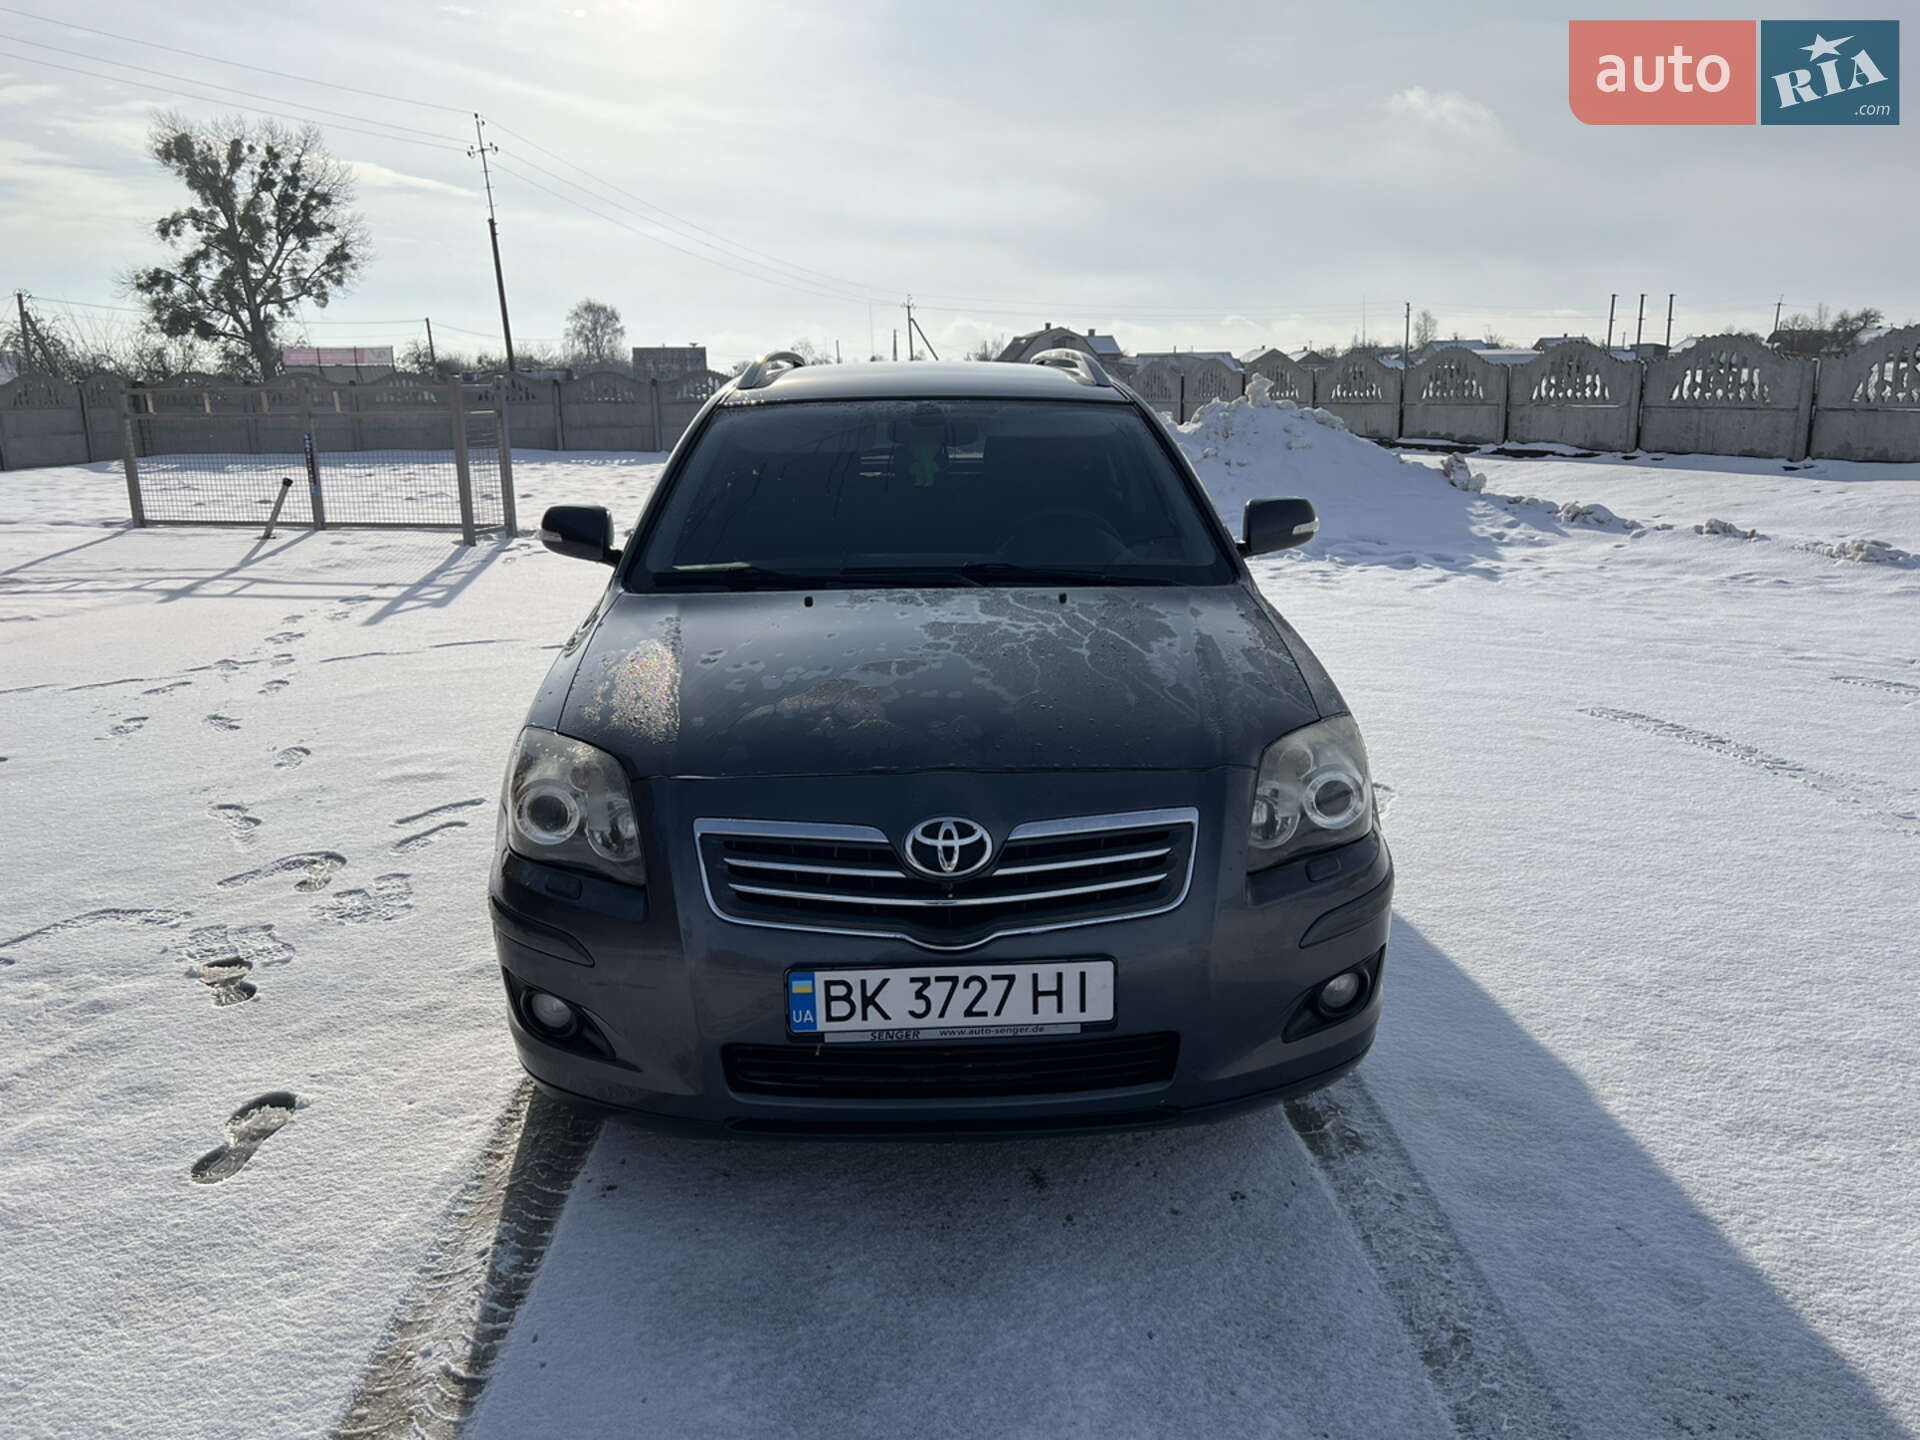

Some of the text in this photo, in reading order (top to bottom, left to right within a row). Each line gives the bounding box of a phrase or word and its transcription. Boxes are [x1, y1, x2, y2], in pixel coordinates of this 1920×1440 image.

[824, 971, 1087, 1023] BK 3727 HI
[792, 1009, 815, 1024] UA
[869, 1025, 1045, 1041] SENGER www.auto-senger.de
